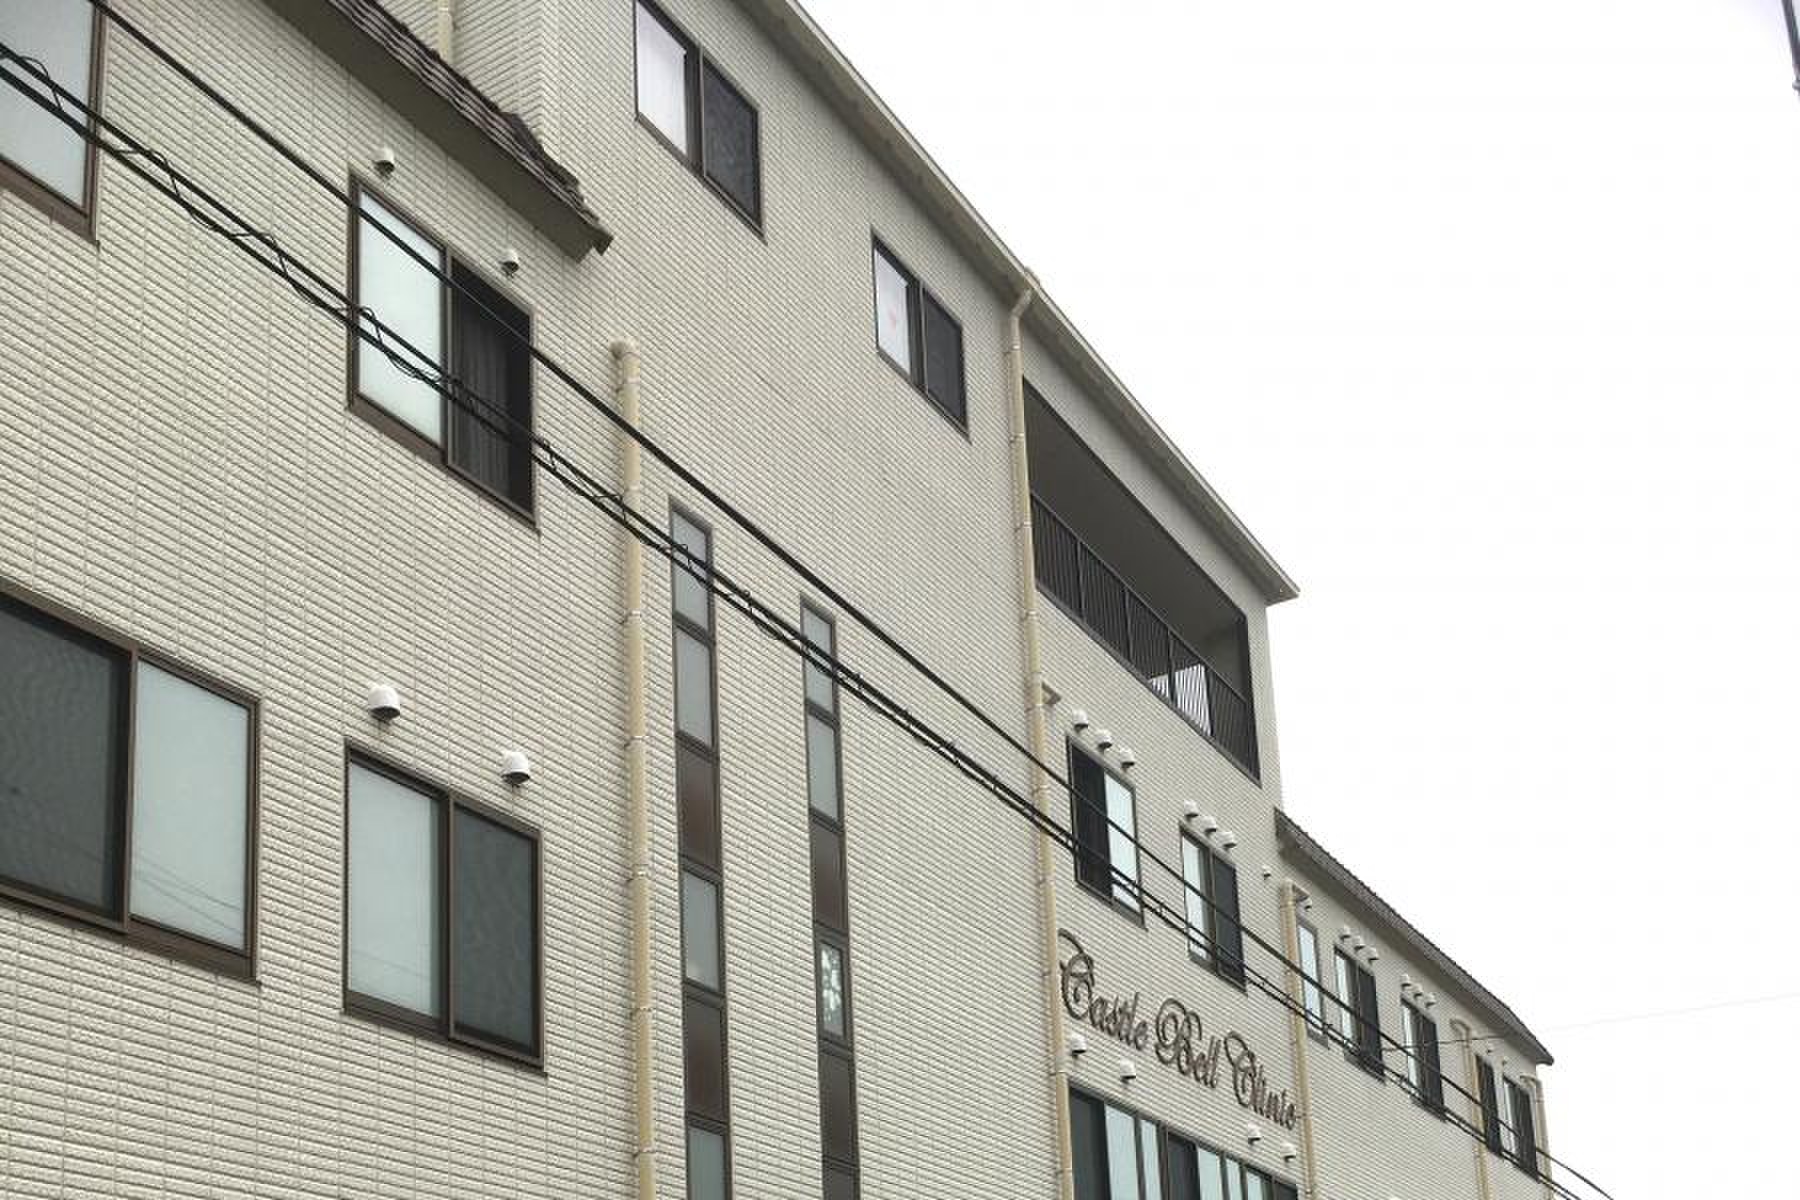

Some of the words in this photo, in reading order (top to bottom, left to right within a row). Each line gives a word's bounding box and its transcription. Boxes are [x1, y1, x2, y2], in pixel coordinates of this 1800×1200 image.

[1058, 928, 1148, 1051] Castle
[1154, 998, 1222, 1089] Bell
[1223, 1031, 1297, 1131] Clinic
